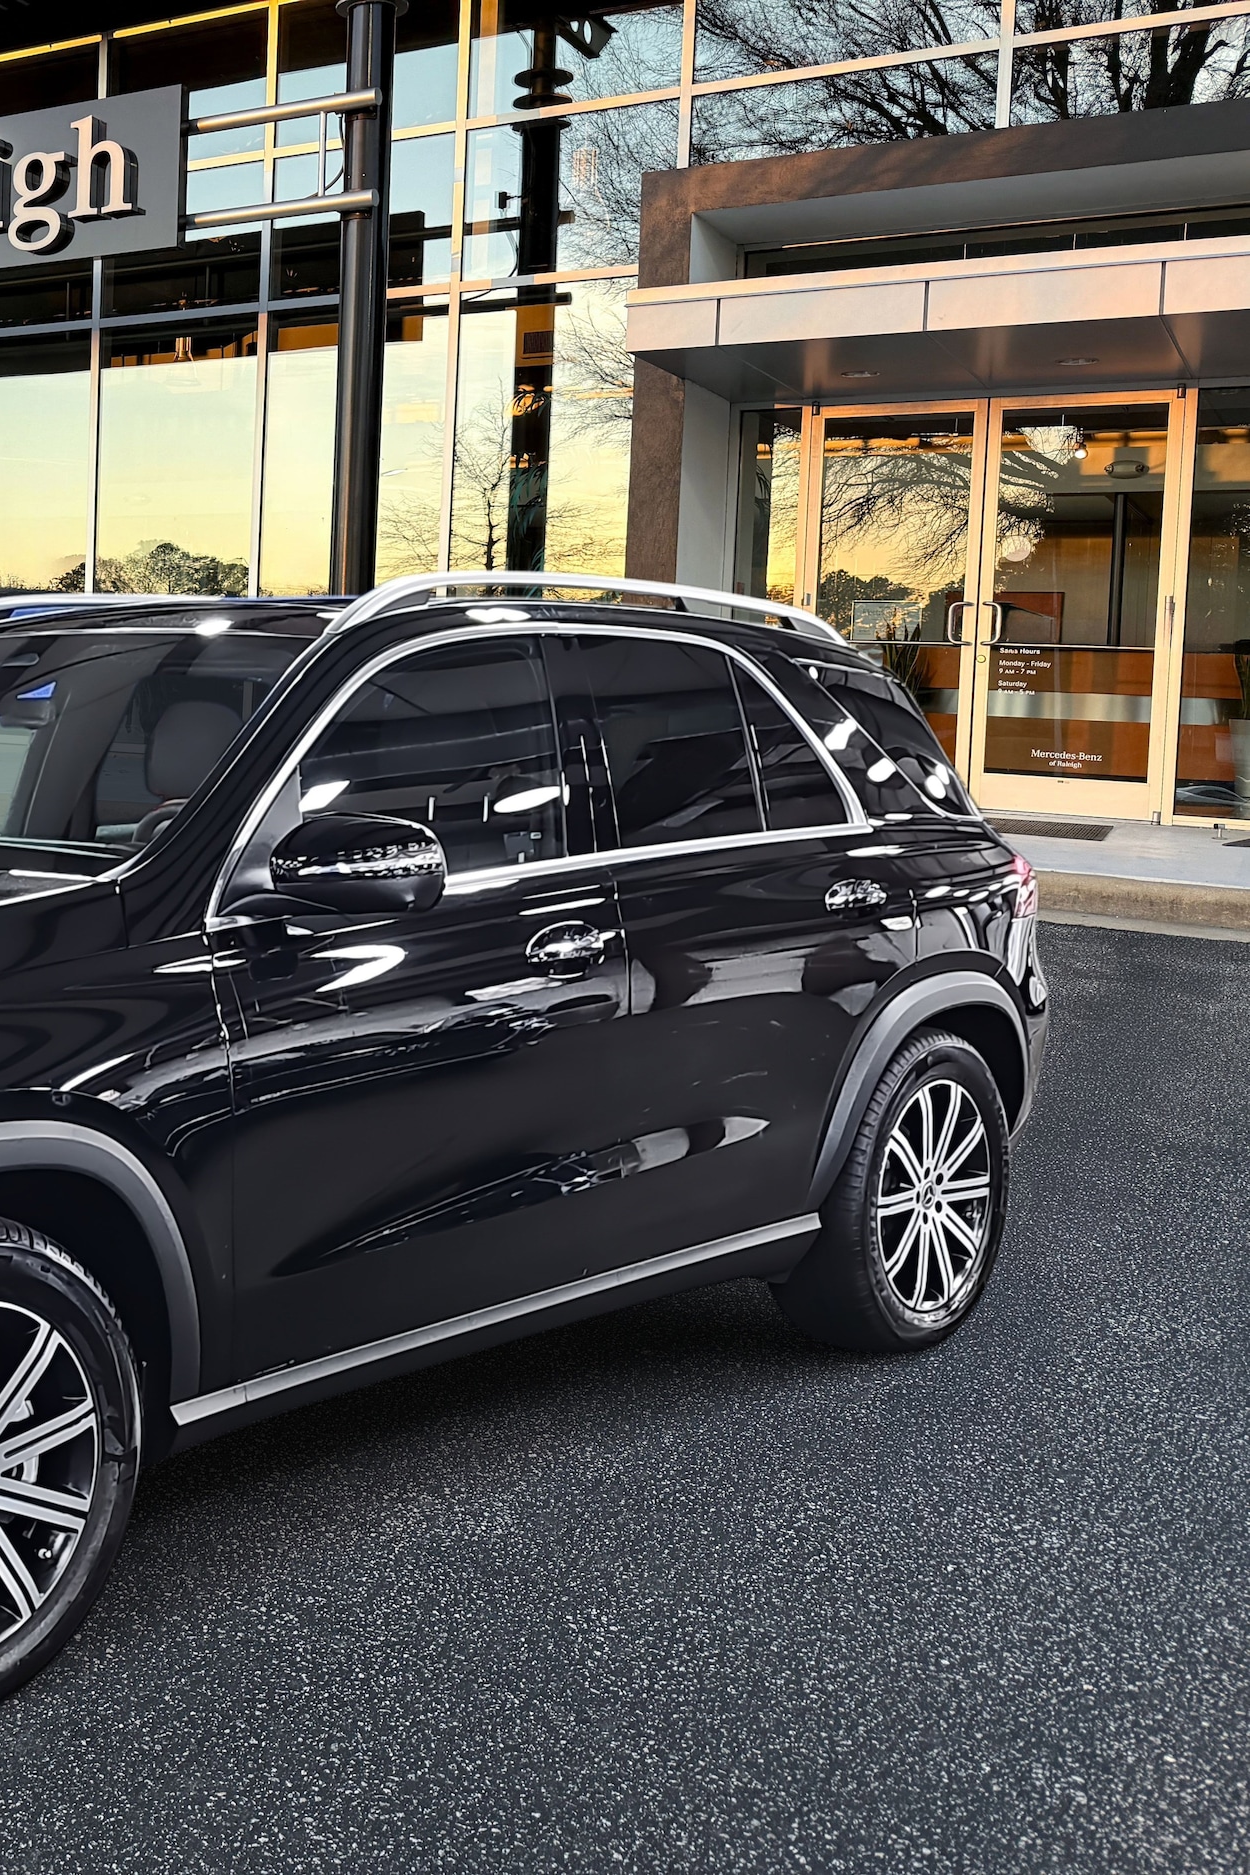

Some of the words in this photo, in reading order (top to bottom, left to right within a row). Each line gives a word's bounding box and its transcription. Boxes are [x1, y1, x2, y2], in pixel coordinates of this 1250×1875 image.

[999, 660, 1025, 668] Monday
[998, 680, 1027, 688] Saturday
[1031, 749, 1102, 761] Mercedes-Benz
